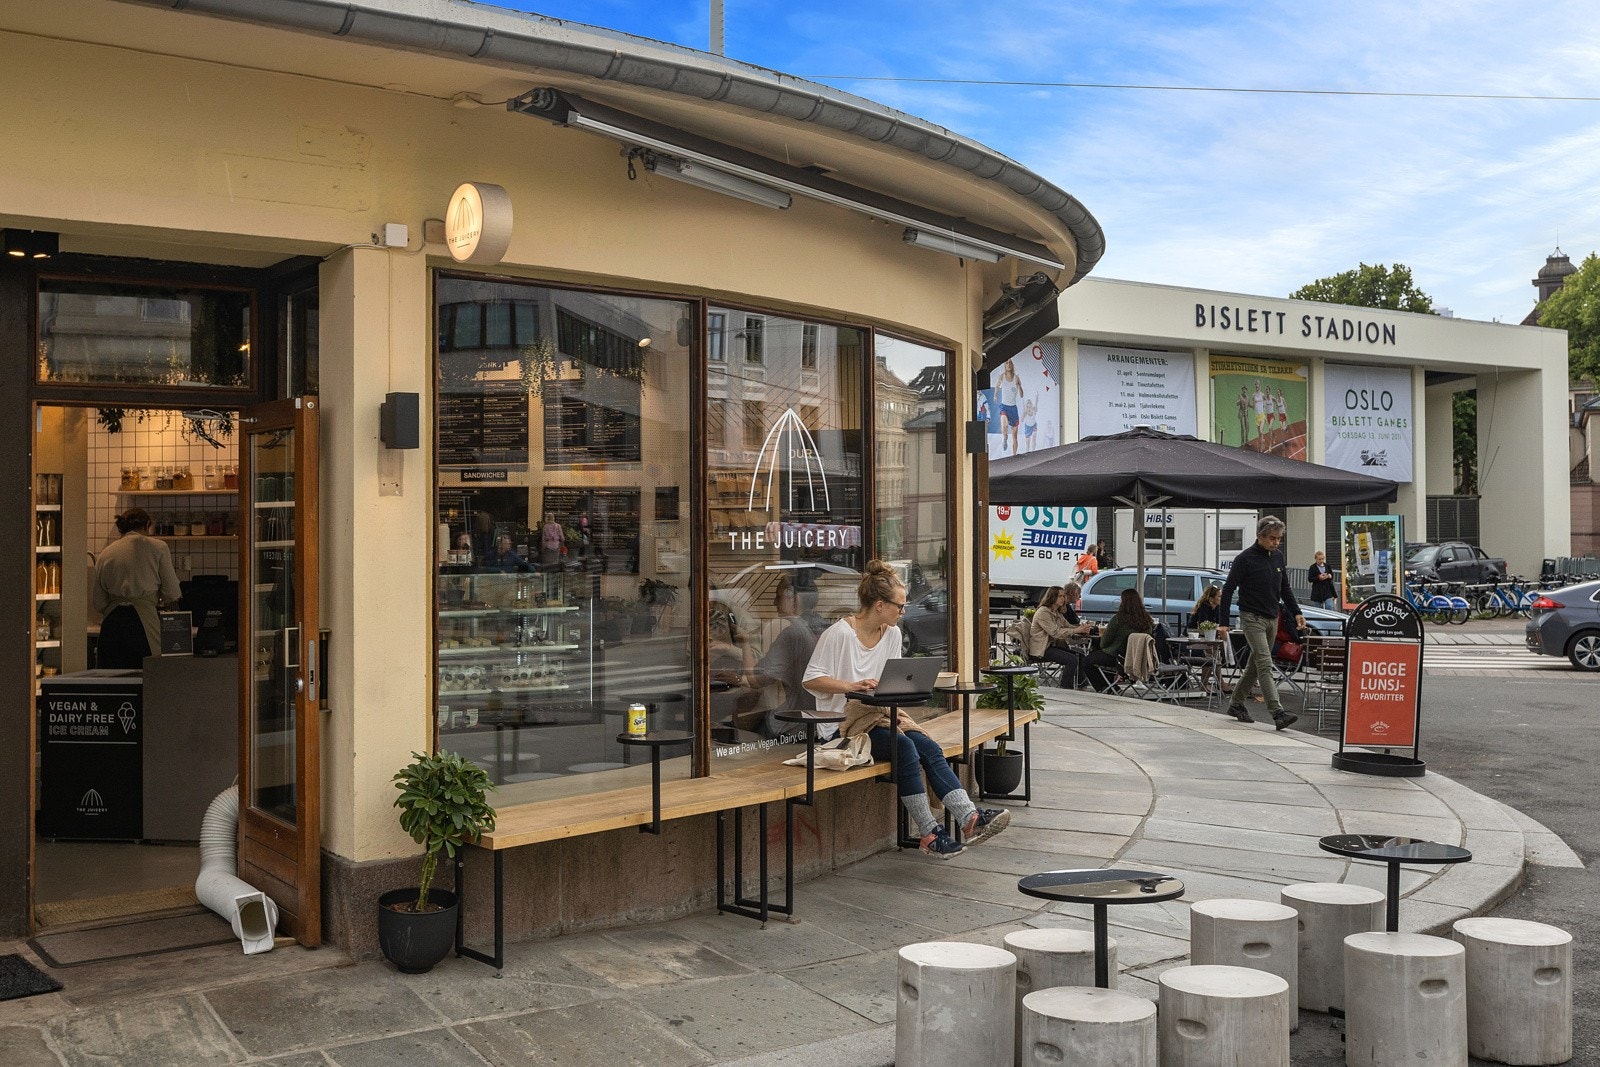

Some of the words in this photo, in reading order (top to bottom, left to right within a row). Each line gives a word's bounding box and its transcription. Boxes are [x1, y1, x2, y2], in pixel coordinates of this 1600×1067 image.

[448, 236, 458, 244] THE
[1195, 303, 1286, 335] BISLETT
[1301, 314, 1396, 346] STADION
[1107, 354, 1169, 366] ARRANGEMENTER:
[1345, 388, 1393, 411] OSLO
[1331, 415, 1373, 426] BISLETT
[1377, 417, 1408, 428] GAMES
[1338, 431, 1367, 439] TORSDAG
[463, 471, 505, 479] SANDWICHES
[1021, 505, 1089, 531] OSLO
[1146, 514, 1173, 523] HIBS
[728, 531, 765, 550] THE
[774, 529, 848, 549] JUICERY
[1033, 532, 1084, 547] BILUTLEIE
[1020, 548, 1035, 558] 22
[1038, 550, 1053, 559] 60
[1056, 551, 1070, 561] 12
[1363, 601, 1385, 619] Godt
[1386, 601, 1410, 620] Brød
[1361, 661, 1407, 677] DIGGE
[1360, 677, 1405, 692] LUNSJ-
[1360, 692, 1405, 702] FAVORITTER
[49, 701, 87, 711] VEGAN
[90, 701, 99, 711] &
[49, 713, 83, 723] DAIRY
[86, 713, 115, 723] FREE
[49, 724, 68, 736] ICE
[69, 725, 109, 736] CREAM
[716, 747, 728, 758] We
[728, 746, 740, 756] are
[757, 737, 780, 750] Vegan,
[780, 733, 798, 745] Dairy,
